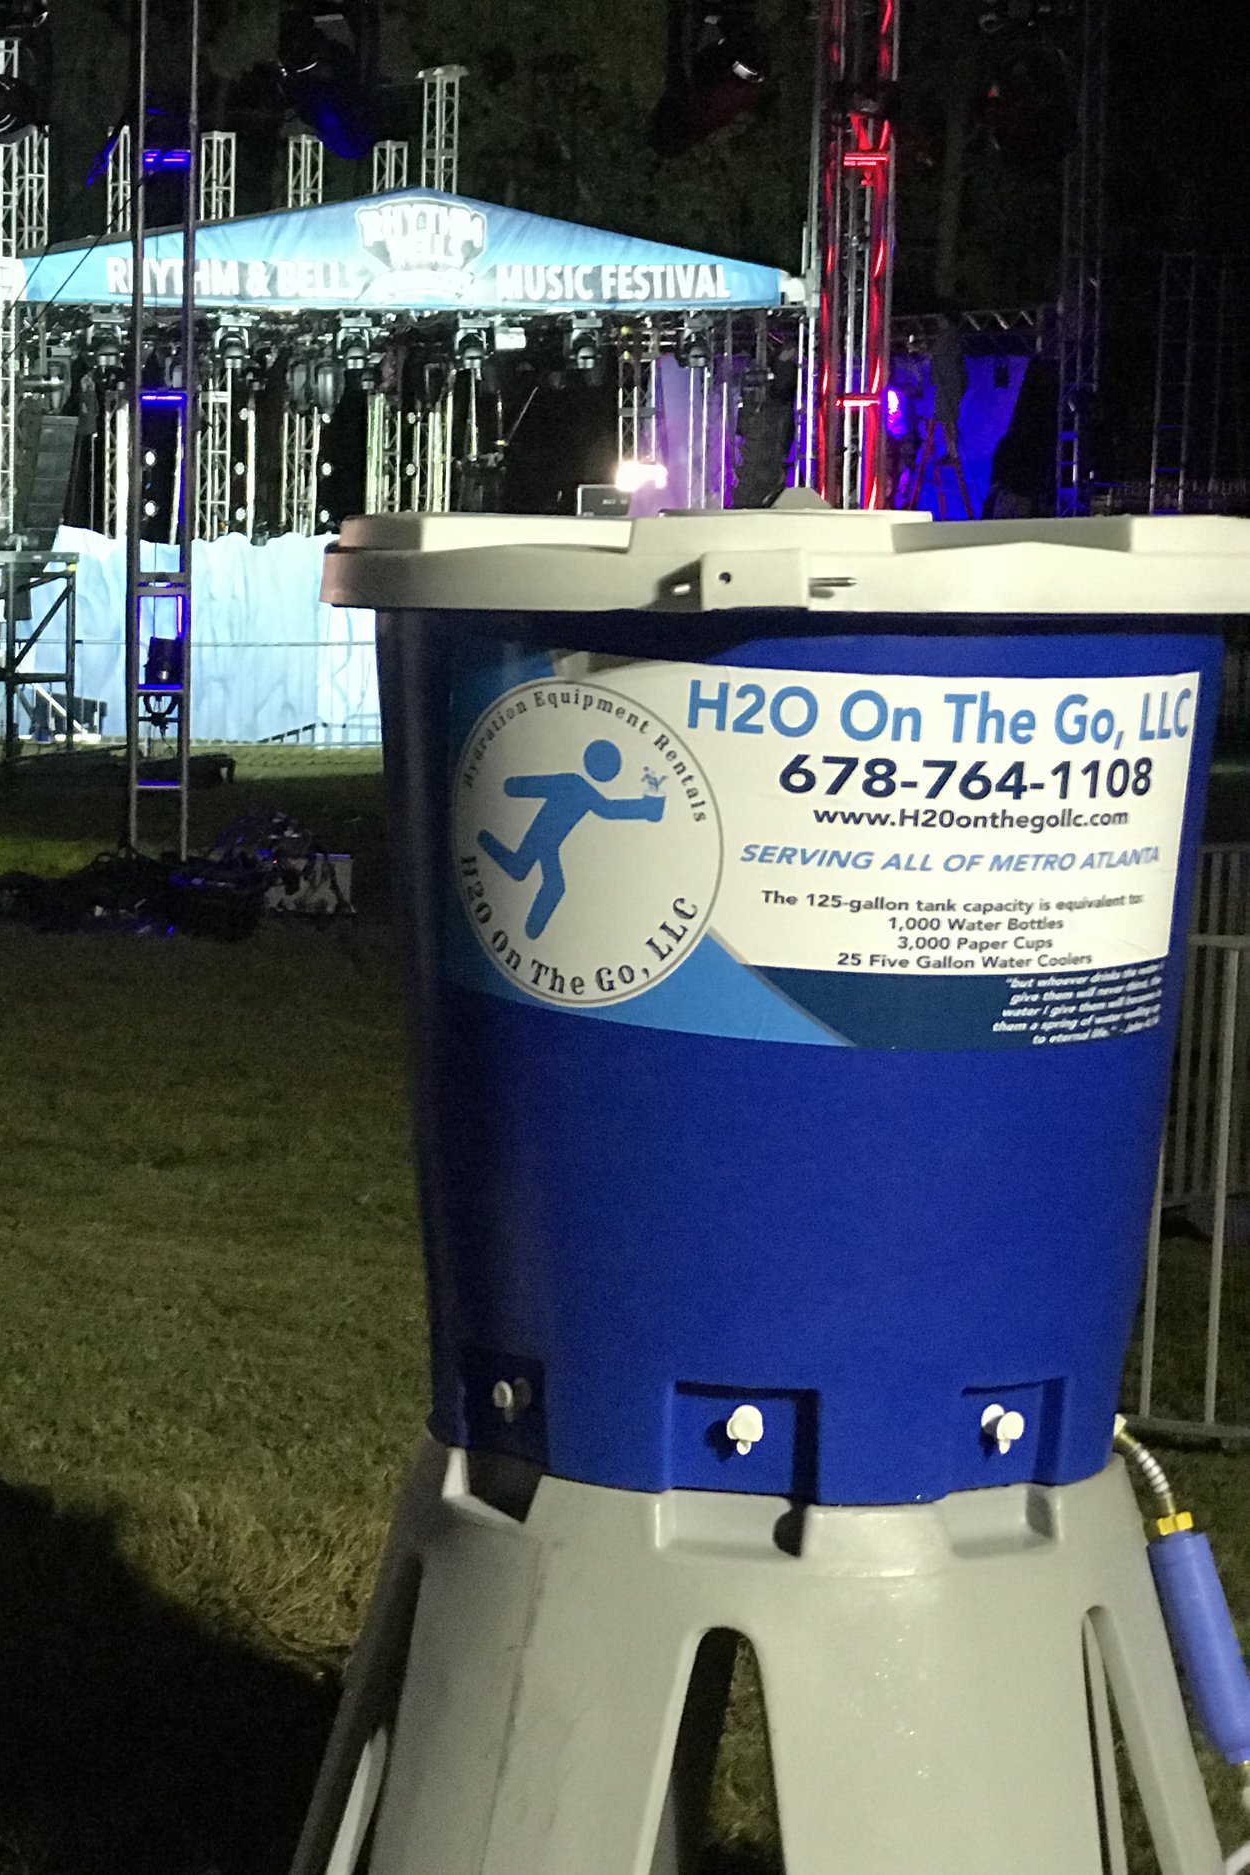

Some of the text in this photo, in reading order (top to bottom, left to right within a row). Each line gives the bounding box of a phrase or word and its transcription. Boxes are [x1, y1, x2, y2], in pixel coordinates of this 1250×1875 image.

[246, 260, 272, 298] &
[495, 263, 594, 300] MUSIC
[602, 263, 731, 300] FESTIVAL
[687, 679, 1192, 750] H2O On The Go, LLC
[461, 688, 708, 822] Hydration Equipment Rentals
[779, 754, 1152, 800] 678-764-1108
[739, 843, 1159, 873] SERVING ALL OF METRO ATLANTA
[762, 889, 798, 906] The
[806, 893, 909, 913] 125-gallon
[916, 898, 956, 912] tank
[963, 897, 1034, 915] capacity
[1038, 897, 1050, 911] is
[1055, 894, 1125, 912] equivalent
[461, 855, 699, 995] H2O On The Go, LLC
[888, 916, 1064, 932] 1,000 Water Bottles
[837, 952, 1093, 969] 25 Five Gallon Water Coolers
[897, 935, 1053, 953] 3,000 Paper Cups
